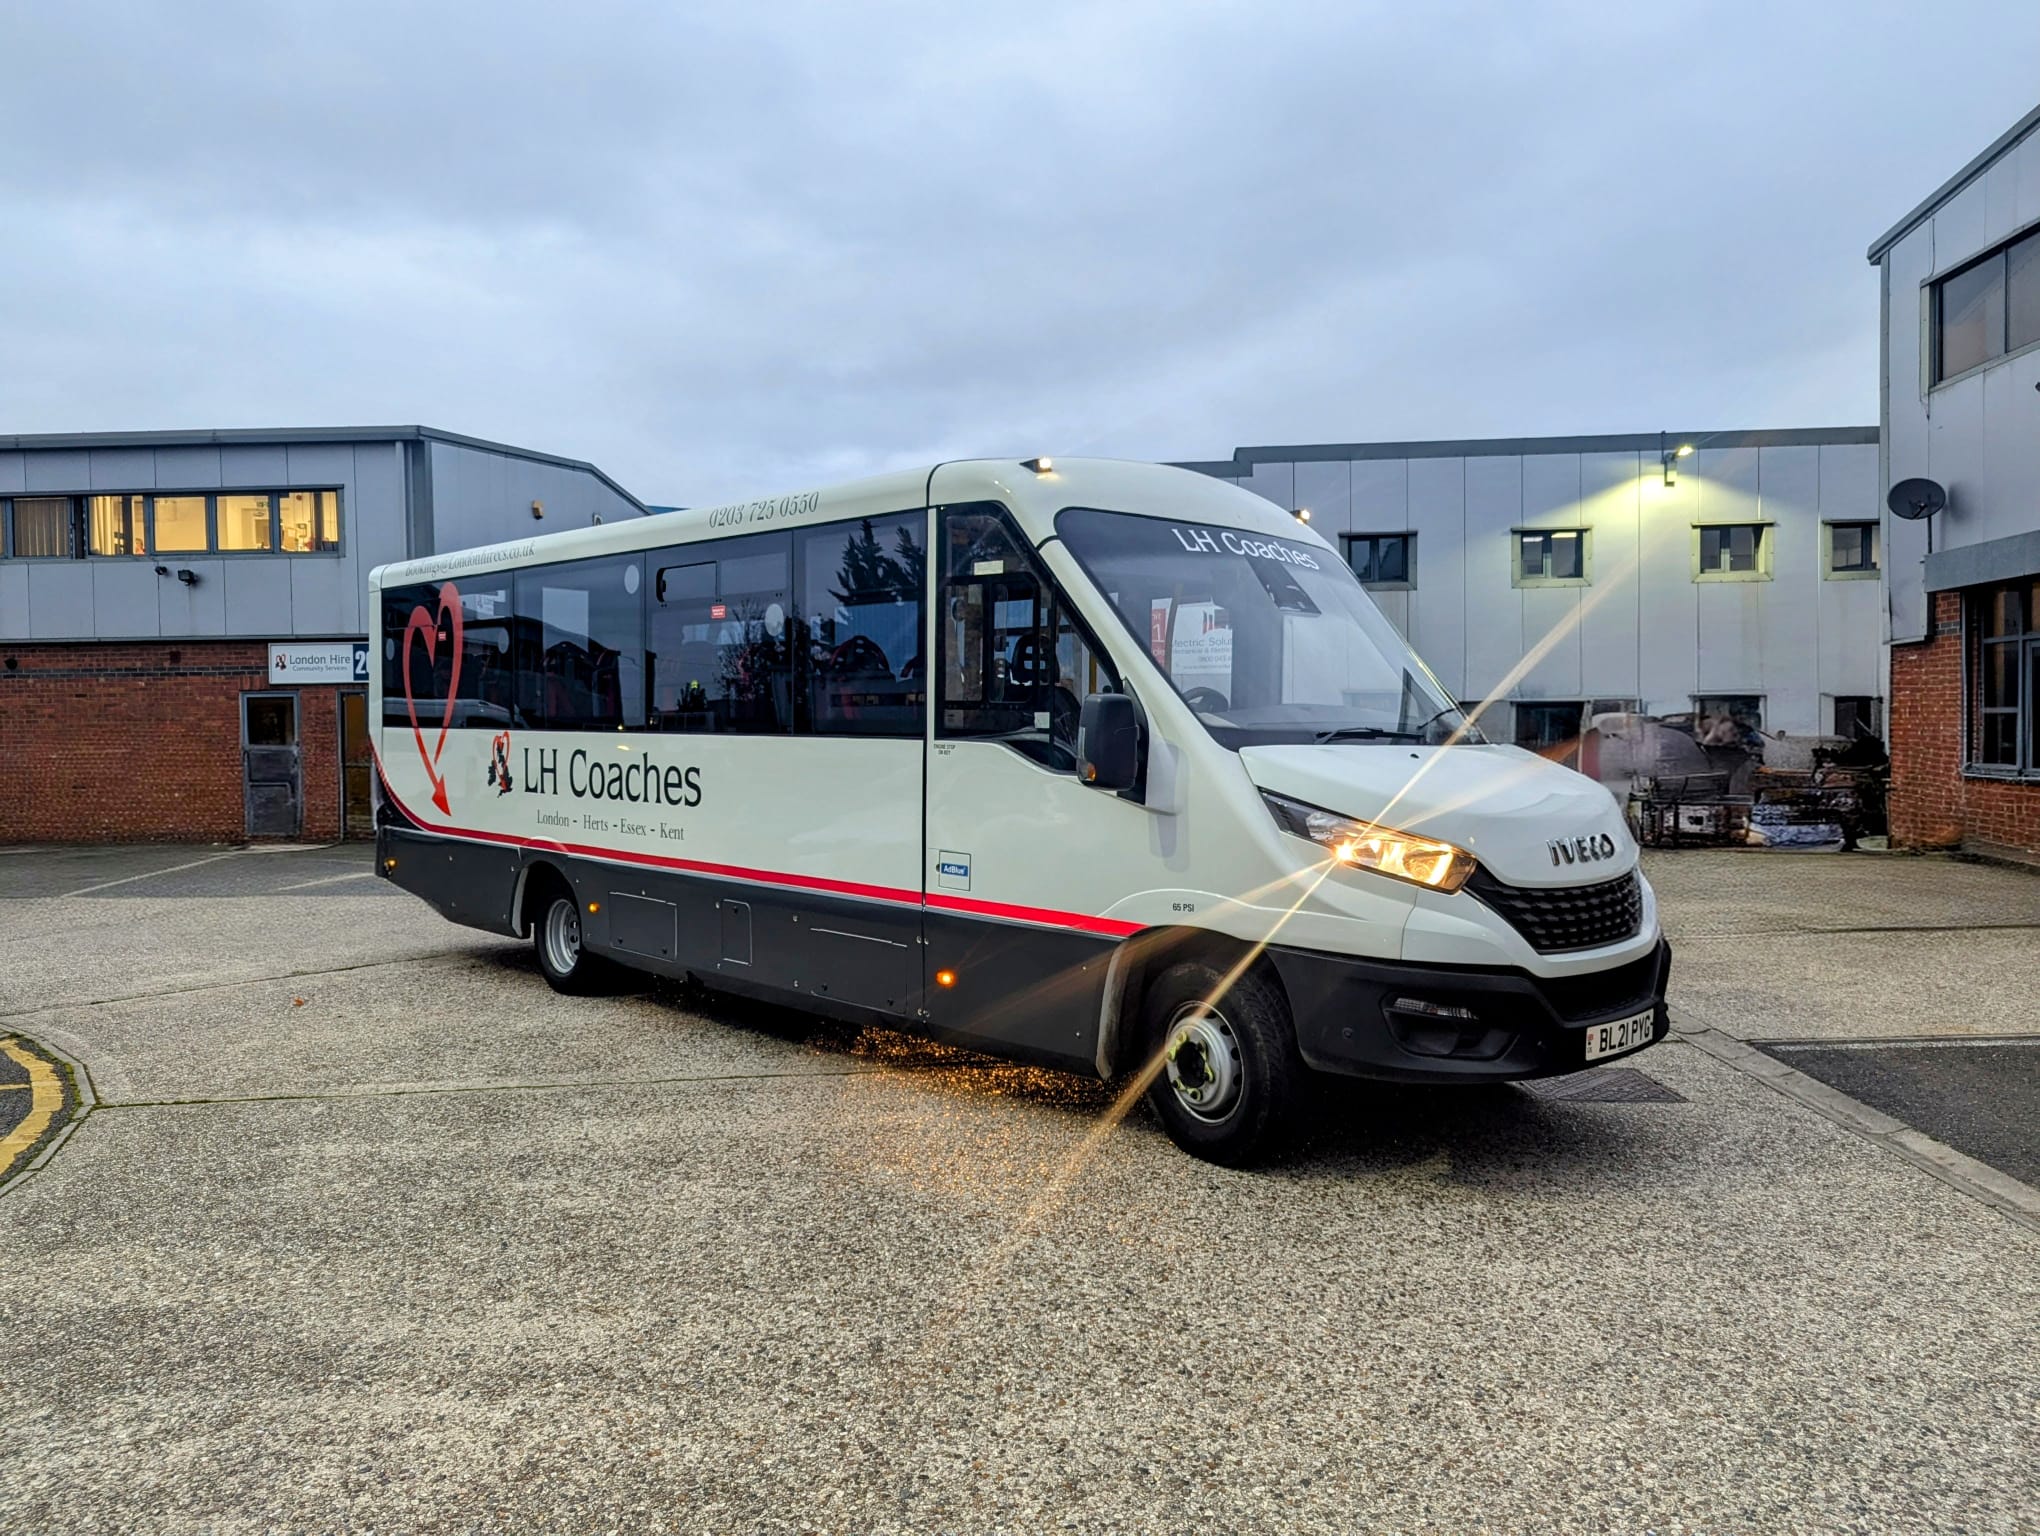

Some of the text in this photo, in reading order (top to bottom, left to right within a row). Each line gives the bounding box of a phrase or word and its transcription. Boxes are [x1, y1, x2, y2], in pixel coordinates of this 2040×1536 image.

[709, 491, 820, 528] 0203 725 0550
[1171, 528, 1320, 570] LH Coaches
[289, 654, 351, 664] London Hire
[354, 650, 369, 675] 2
[523, 747, 702, 807] LH Coaches
[536, 809, 570, 828] London
[583, 813, 609, 832] Herts
[620, 818, 647, 836] Essex
[659, 822, 685, 841] Kent
[1546, 832, 1615, 867] IVECO
[1172, 902, 1195, 912] 65 PSI
[1631, 1014, 1651, 1044] PYG
